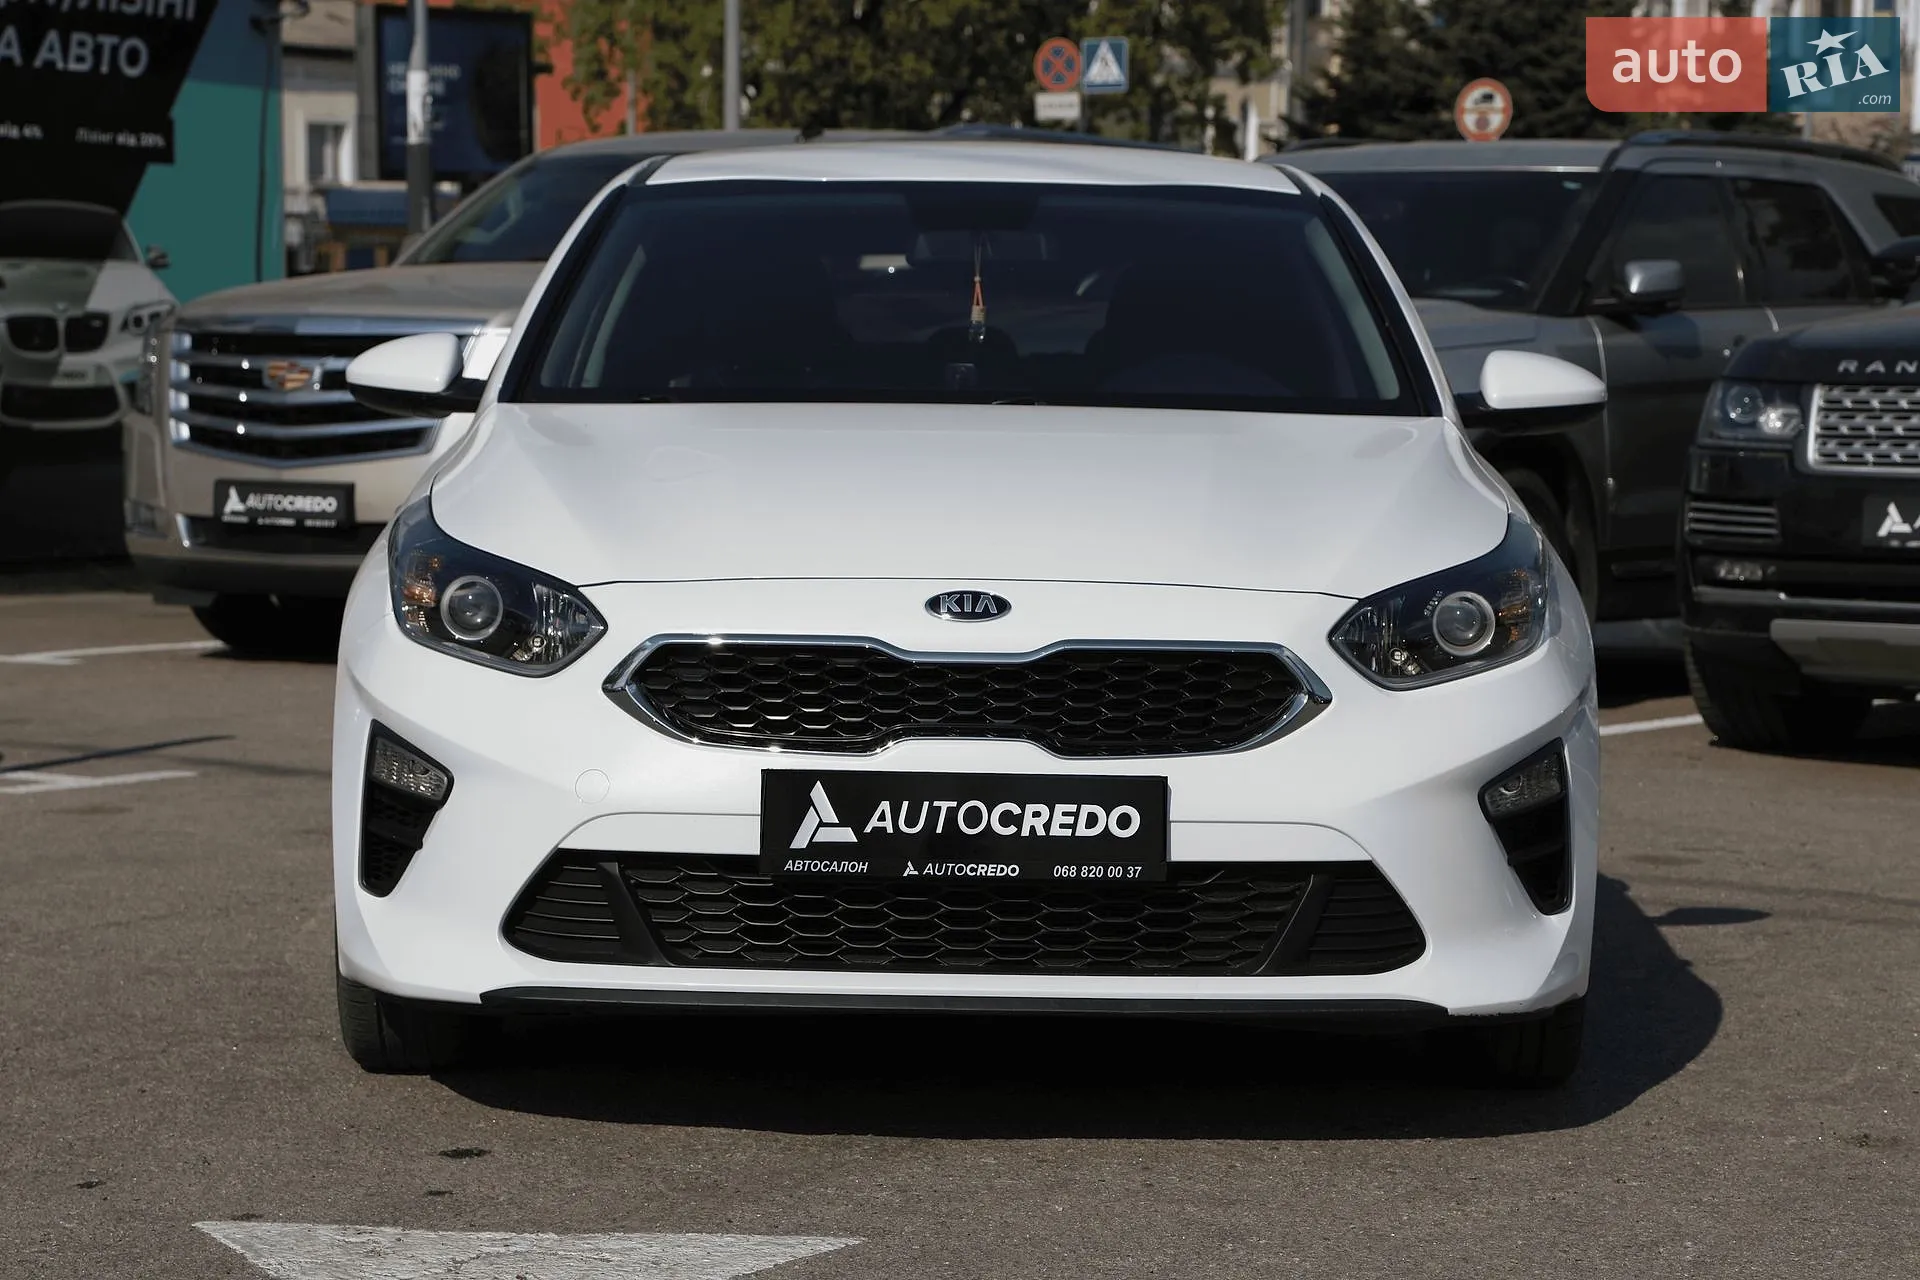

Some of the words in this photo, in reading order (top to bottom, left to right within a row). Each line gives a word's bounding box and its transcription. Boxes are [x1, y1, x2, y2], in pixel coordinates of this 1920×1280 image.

[33, 28, 149, 77] АВТО
[246, 493, 338, 513] AUTOCREDO
[940, 594, 998, 613] KIA
[863, 800, 1141, 839] AUTOCREDO
[784, 860, 869, 873] АВТОСАЛОН
[923, 863, 1020, 876] AUTOCREDO
[1053, 865, 1077, 878] 068
[1080, 866, 1104, 878] 820
[1107, 866, 1123, 878] 00
[1126, 866, 1142, 878] 37
